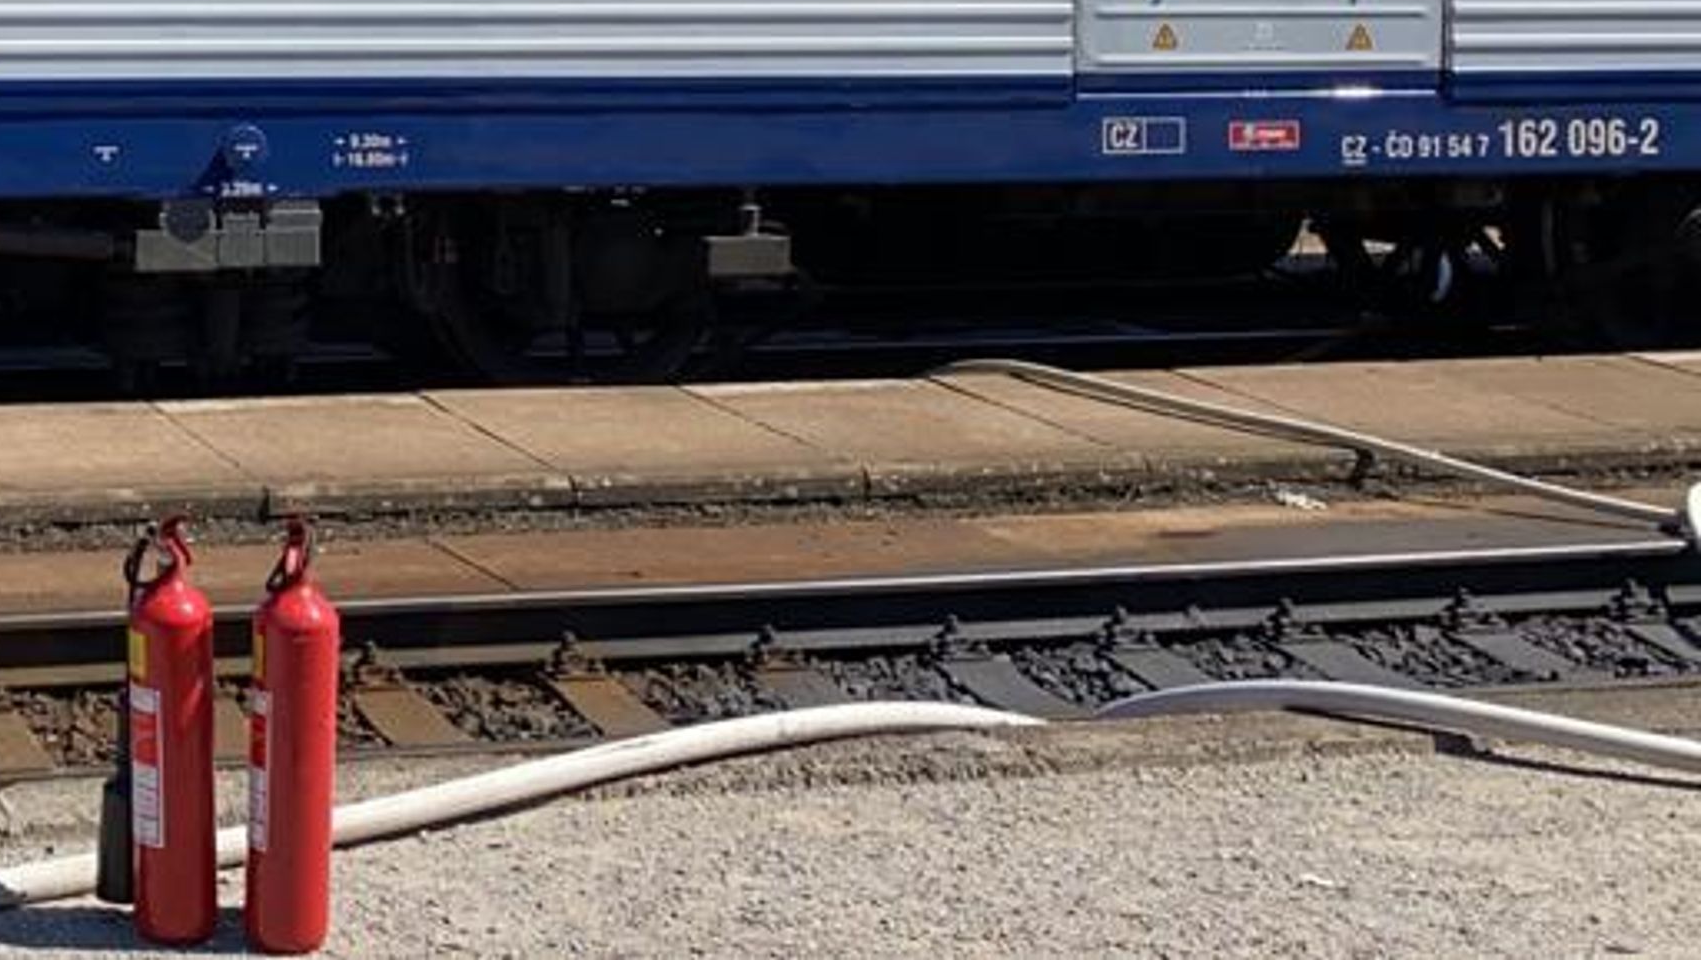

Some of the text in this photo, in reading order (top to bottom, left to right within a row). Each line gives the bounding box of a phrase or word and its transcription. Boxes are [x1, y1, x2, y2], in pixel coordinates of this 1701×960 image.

[1109, 122, 1139, 148] CZ
[1341, 135, 1368, 158] CZ
[1384, 129, 1413, 158] ČD
[1418, 135, 1441, 158] 91
[1448, 135, 1472, 158] 54
[1477, 134, 1490, 158] 7
[1497, 118, 1558, 158] 162
[1567, 117, 1660, 157] 096-2
